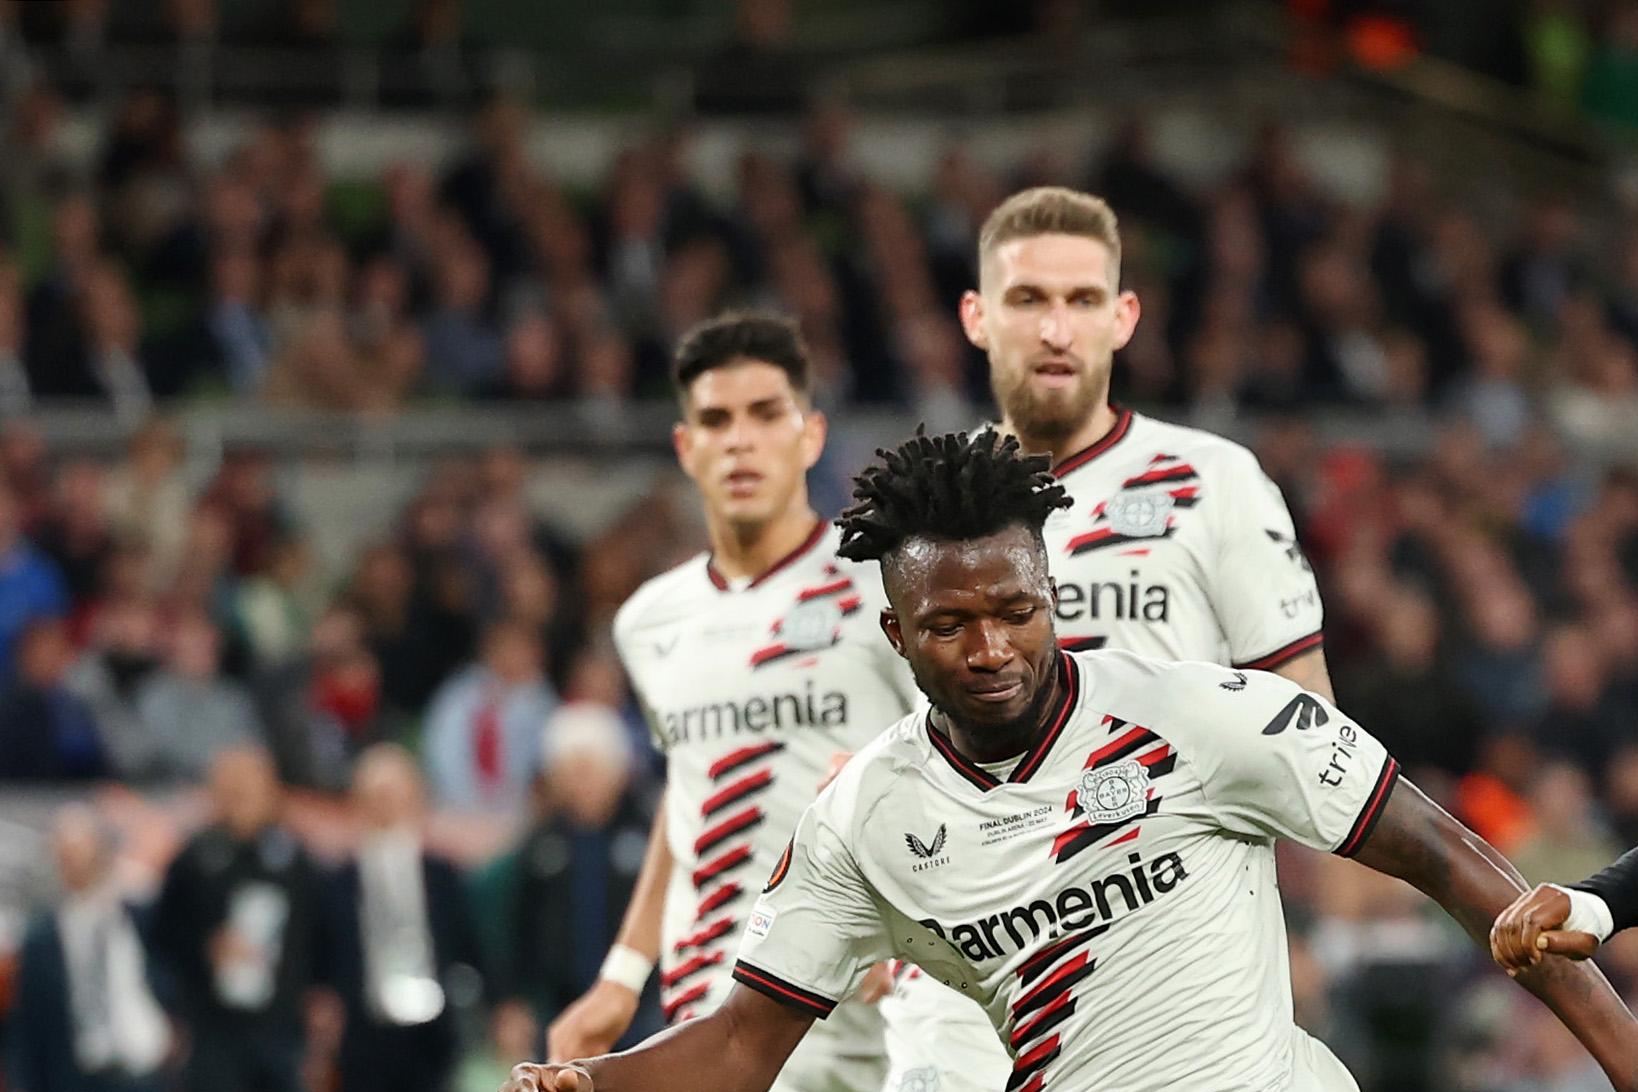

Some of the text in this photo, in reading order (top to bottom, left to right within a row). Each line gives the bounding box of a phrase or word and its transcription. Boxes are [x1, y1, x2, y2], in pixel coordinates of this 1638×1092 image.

[1055, 569, 1169, 622] enia
[660, 680, 849, 746] armenia
[979, 805, 1053, 831] FINAL DUBLIN 2024
[912, 856, 950, 872] CASTORE
